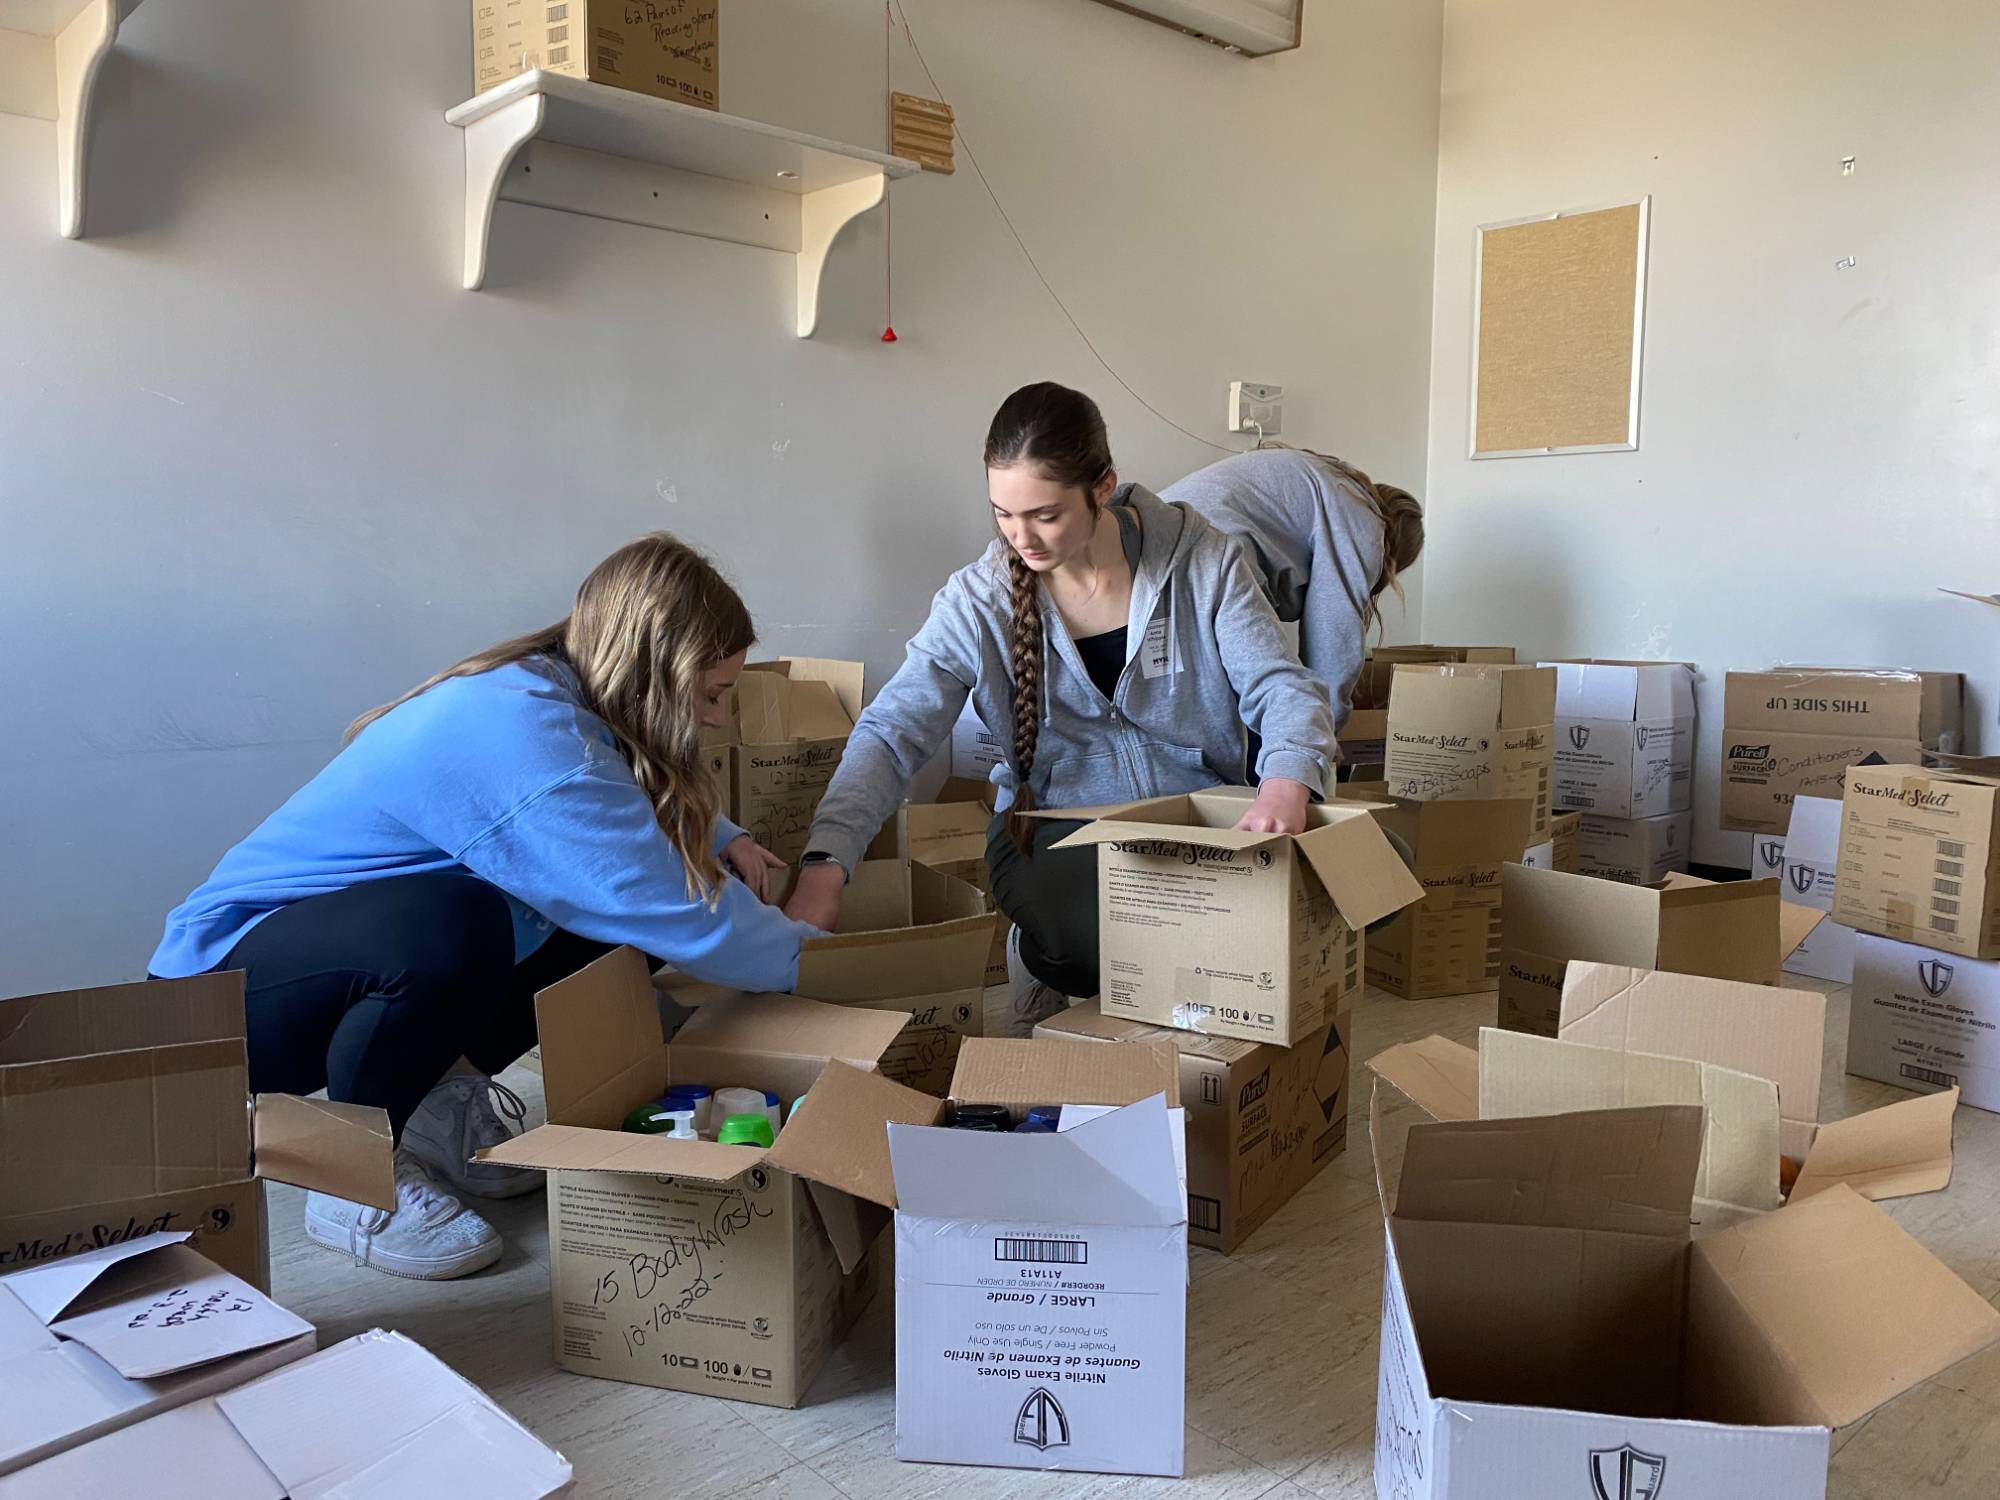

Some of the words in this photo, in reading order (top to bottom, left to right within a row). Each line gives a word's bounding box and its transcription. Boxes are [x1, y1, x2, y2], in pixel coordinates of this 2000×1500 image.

[1766, 697, 1788, 711] UP
[1793, 698, 1828, 712] SIDE
[1832, 699, 1870, 714] THIS
[1853, 782, 1906, 800] StarMed
[1907, 788, 1954, 808] Select
[1894, 994, 1919, 1004] Nitrile
[1922, 1000, 1944, 1009] Exam
[1946, 1004, 1974, 1016] Gloves
[1218, 1008, 1239, 1020] 100
[1874, 998, 1906, 1010] Guantes
[1921, 1008, 1954, 1020] Examen
[1969, 1018, 1996, 1030] Nitrilo
[593, 1270, 619, 1304] 15
[628, 1236, 702, 1300] Body
[698, 1196, 774, 1250] Wash
[1021, 1269, 1062, 1278] A11A13
[986, 1292, 1034, 1304] Grande
[1040, 1293, 1047, 1305] /
[1051, 1296, 1095, 1307] LARGE
[996, 1323, 1015, 1332] solo
[1034, 1325, 1048, 1334] De
[1058, 1326, 1091, 1336] Polvos
[1094, 1327, 1109, 1336] Sin
[968, 1335, 989, 1346] Only
[993, 1337, 1011, 1347] Use
[1014, 1338, 1043, 1348] Single
[1054, 1341, 1076, 1350] Free
[1080, 1342, 1116, 1352] Powder
[943, 1350, 984, 1362] Nitrilo
[989, 1352, 1005, 1362] de
[1008, 1354, 1061, 1366] Examen
[1065, 1355, 1081, 1365] de
[661, 1353, 678, 1367] 10
[704, 1360, 729, 1374] 100
[1085, 1357, 1141, 1369] Guantes
[977, 1367, 1021, 1380] Gloves
[1025, 1370, 1061, 1381] Exam
[1065, 1372, 1106, 1384] Nitrile
